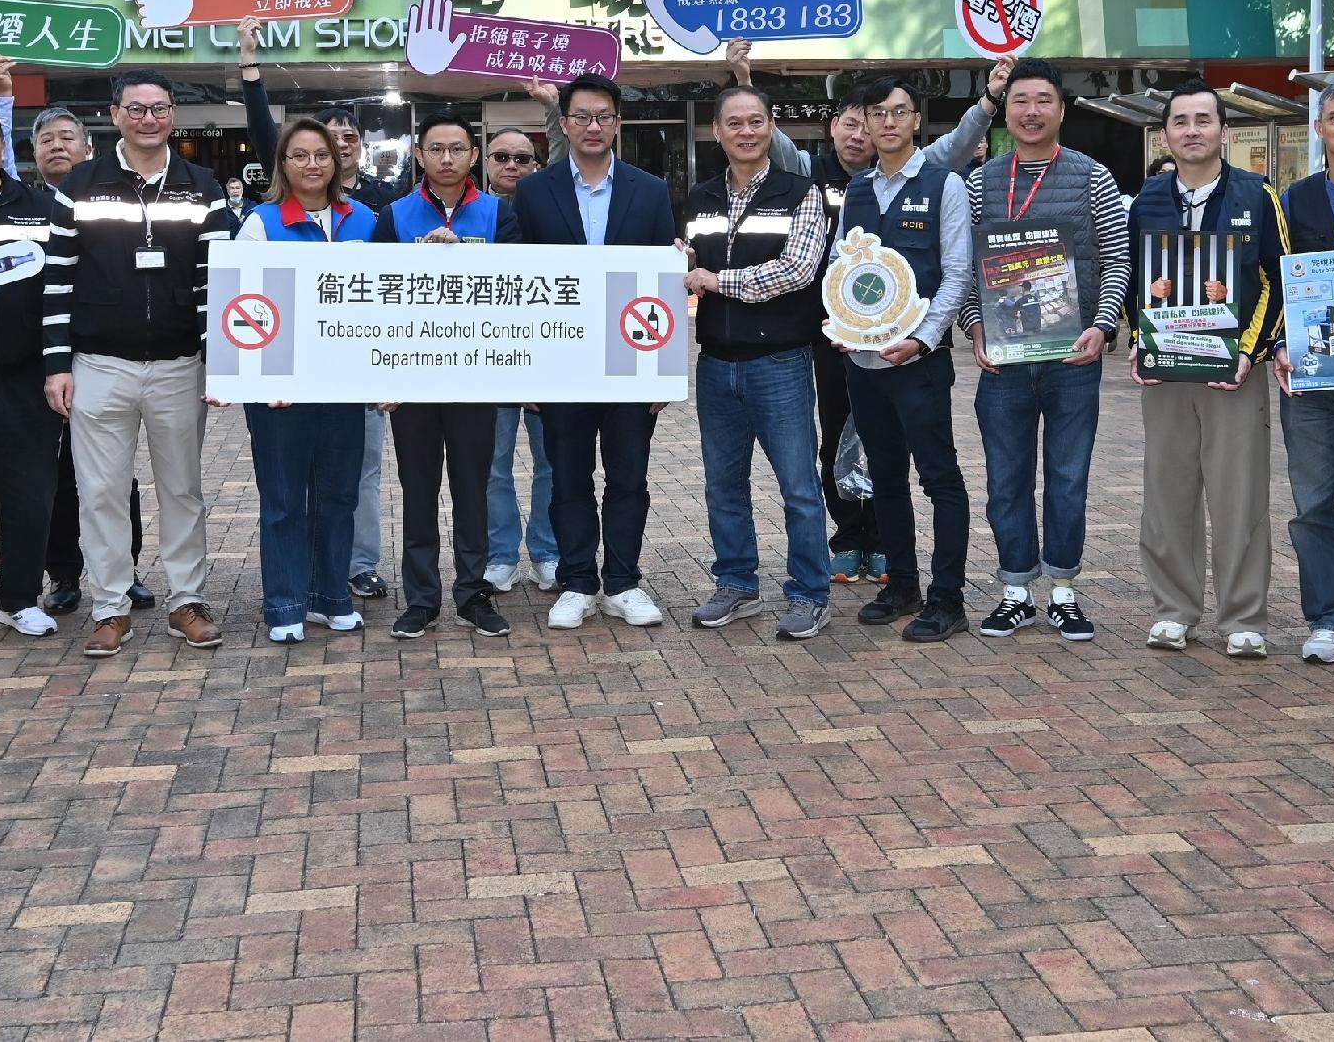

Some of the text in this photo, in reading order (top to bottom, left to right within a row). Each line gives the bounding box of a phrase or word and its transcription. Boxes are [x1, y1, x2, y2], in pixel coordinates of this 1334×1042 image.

[717, 3, 852, 31] 1833 183
[469, 24, 571, 52] 拒絕電子煙
[485, 50, 607, 77] 成為吸毒媒介
[202, 128, 223, 137] coral
[317, 320, 584, 339] Tobacco and Alcohol Control Office
[371, 349, 532, 369] Department of Health
